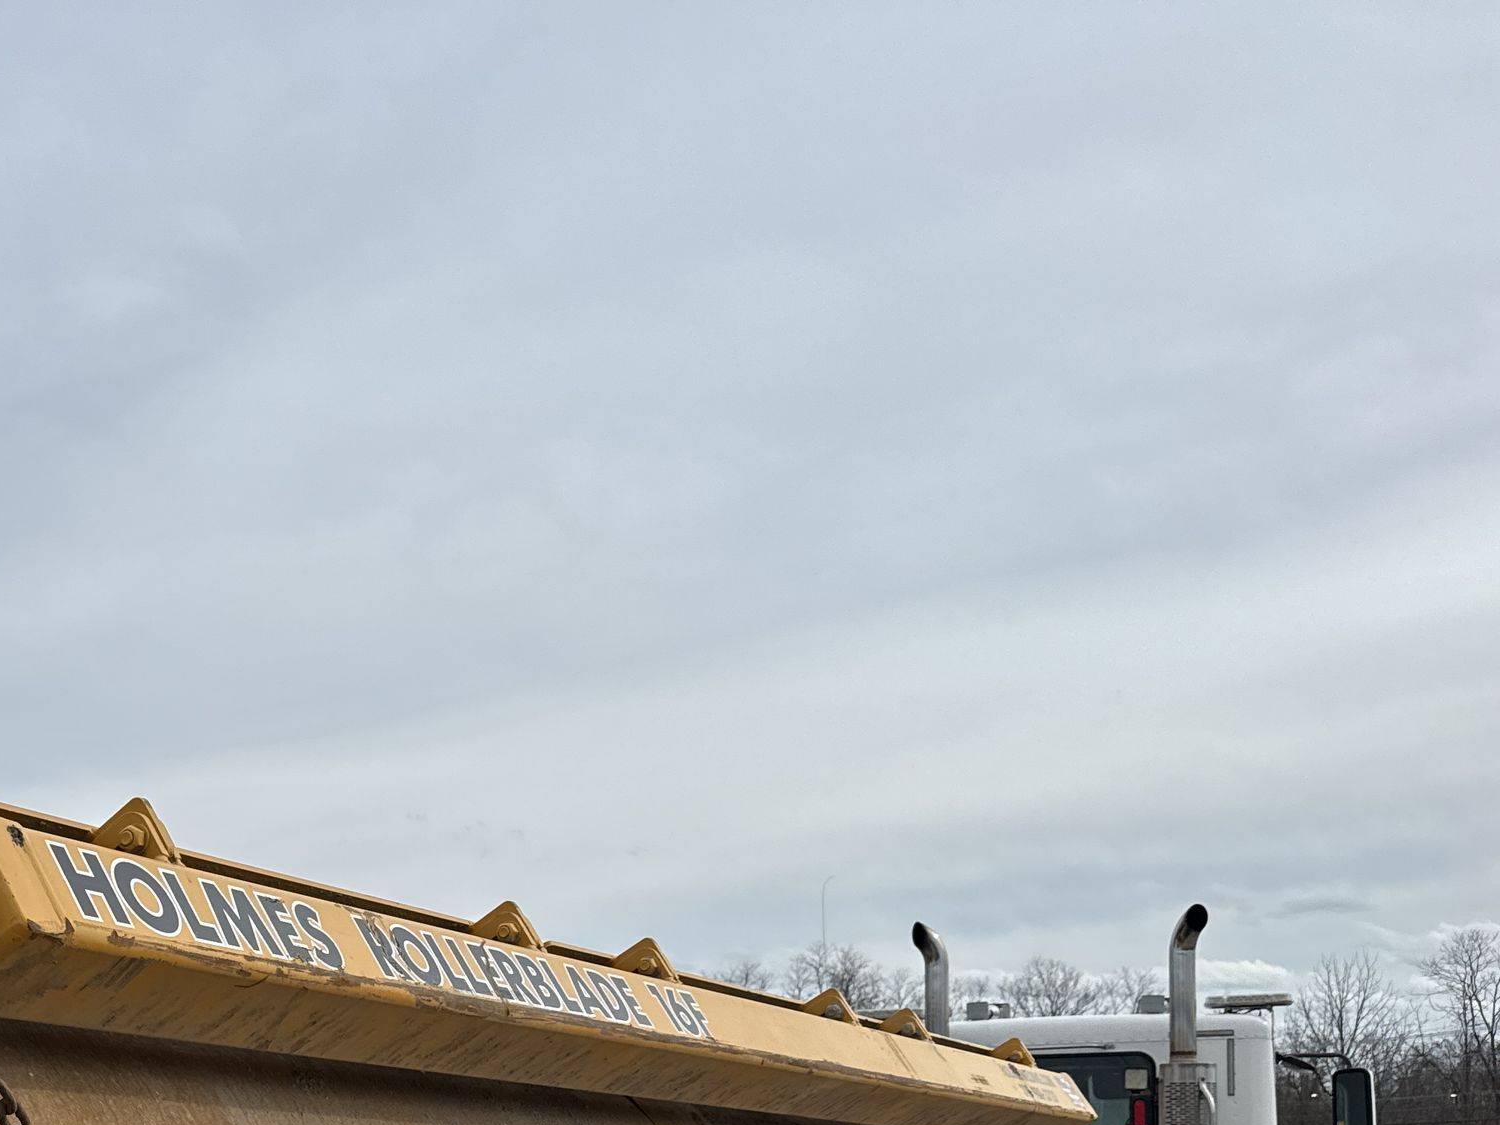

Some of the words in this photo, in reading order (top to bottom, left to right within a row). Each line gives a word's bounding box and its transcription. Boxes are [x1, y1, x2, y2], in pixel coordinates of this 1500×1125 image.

[45, 839, 346, 971] HOLMES
[350, 913, 655, 1029] ROLLERBLADE
[643, 981, 714, 1040] 16F
